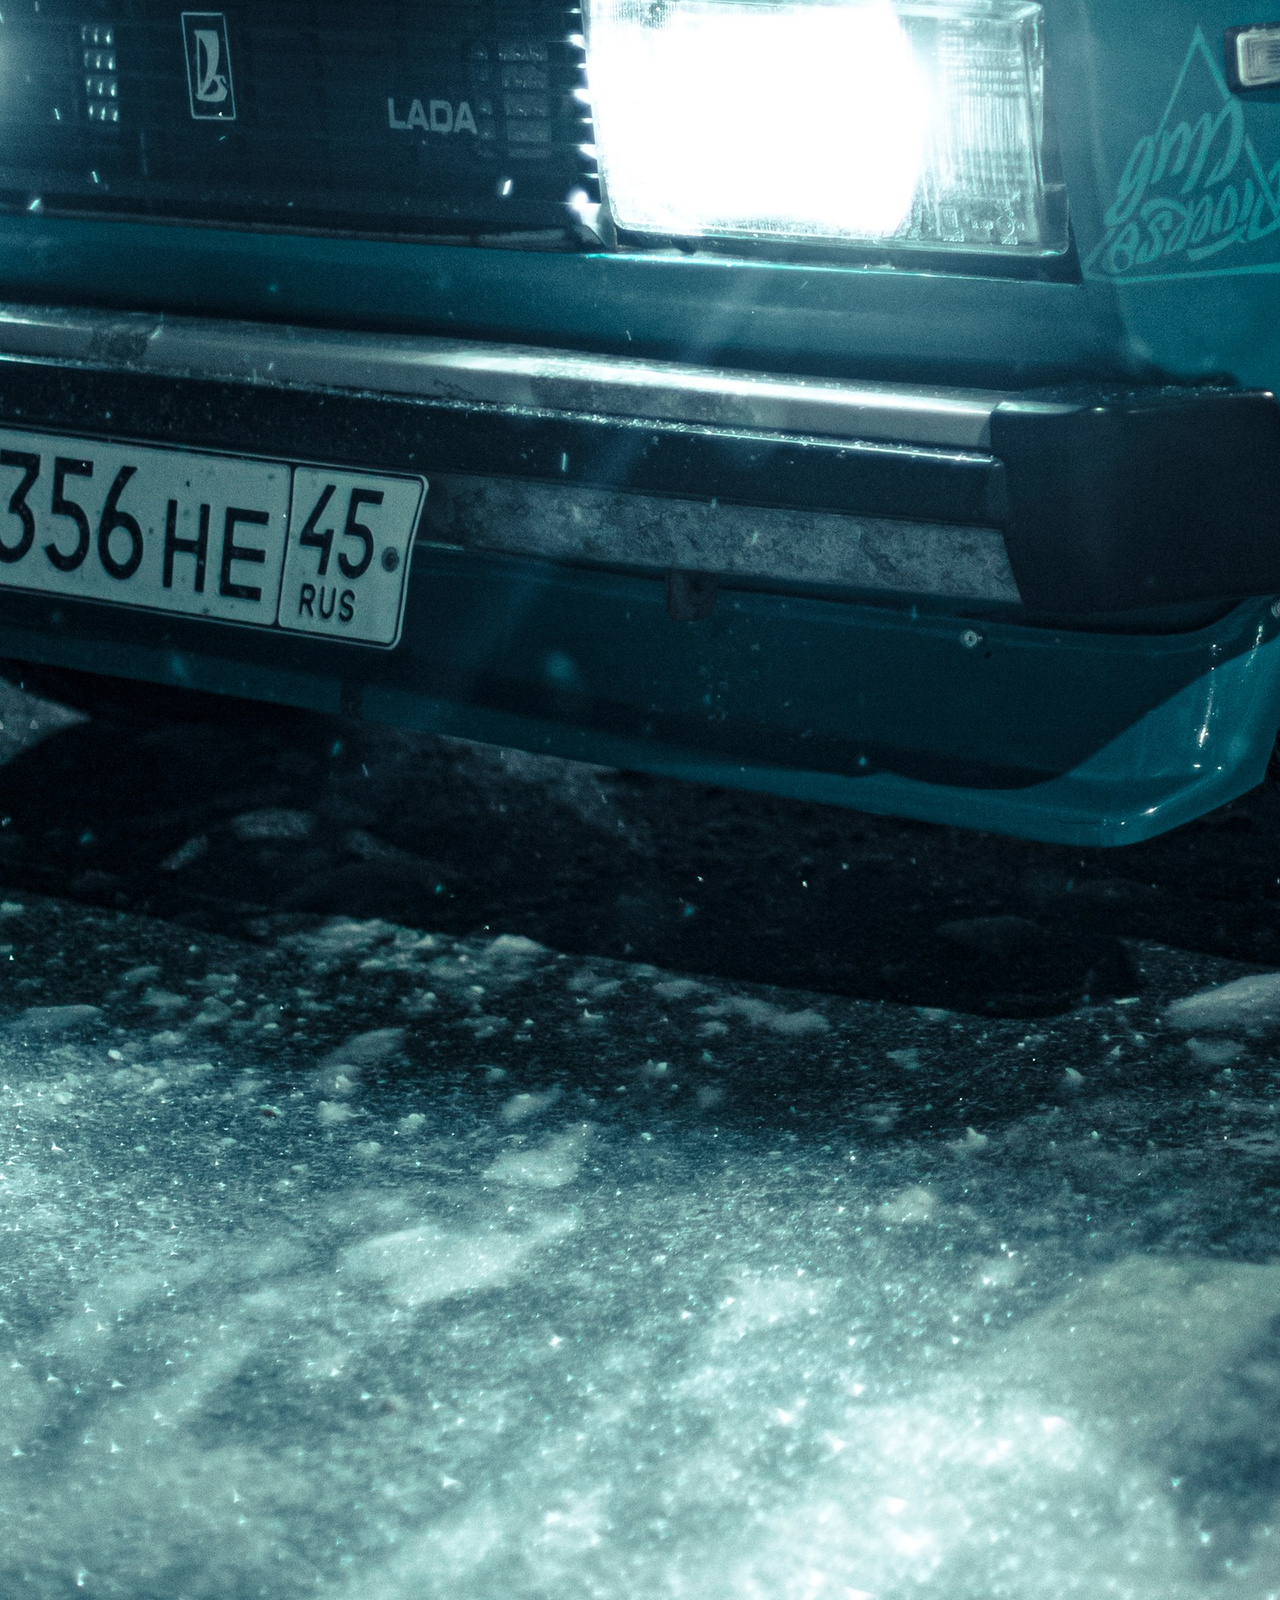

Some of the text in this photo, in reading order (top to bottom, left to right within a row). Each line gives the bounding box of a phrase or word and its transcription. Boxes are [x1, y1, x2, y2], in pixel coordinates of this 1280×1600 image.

[388, 98, 478, 135] LADA
[1106, 103, 1244, 226] Club
[300, 483, 385, 580] 45
[300, 582, 356, 623] RUS
